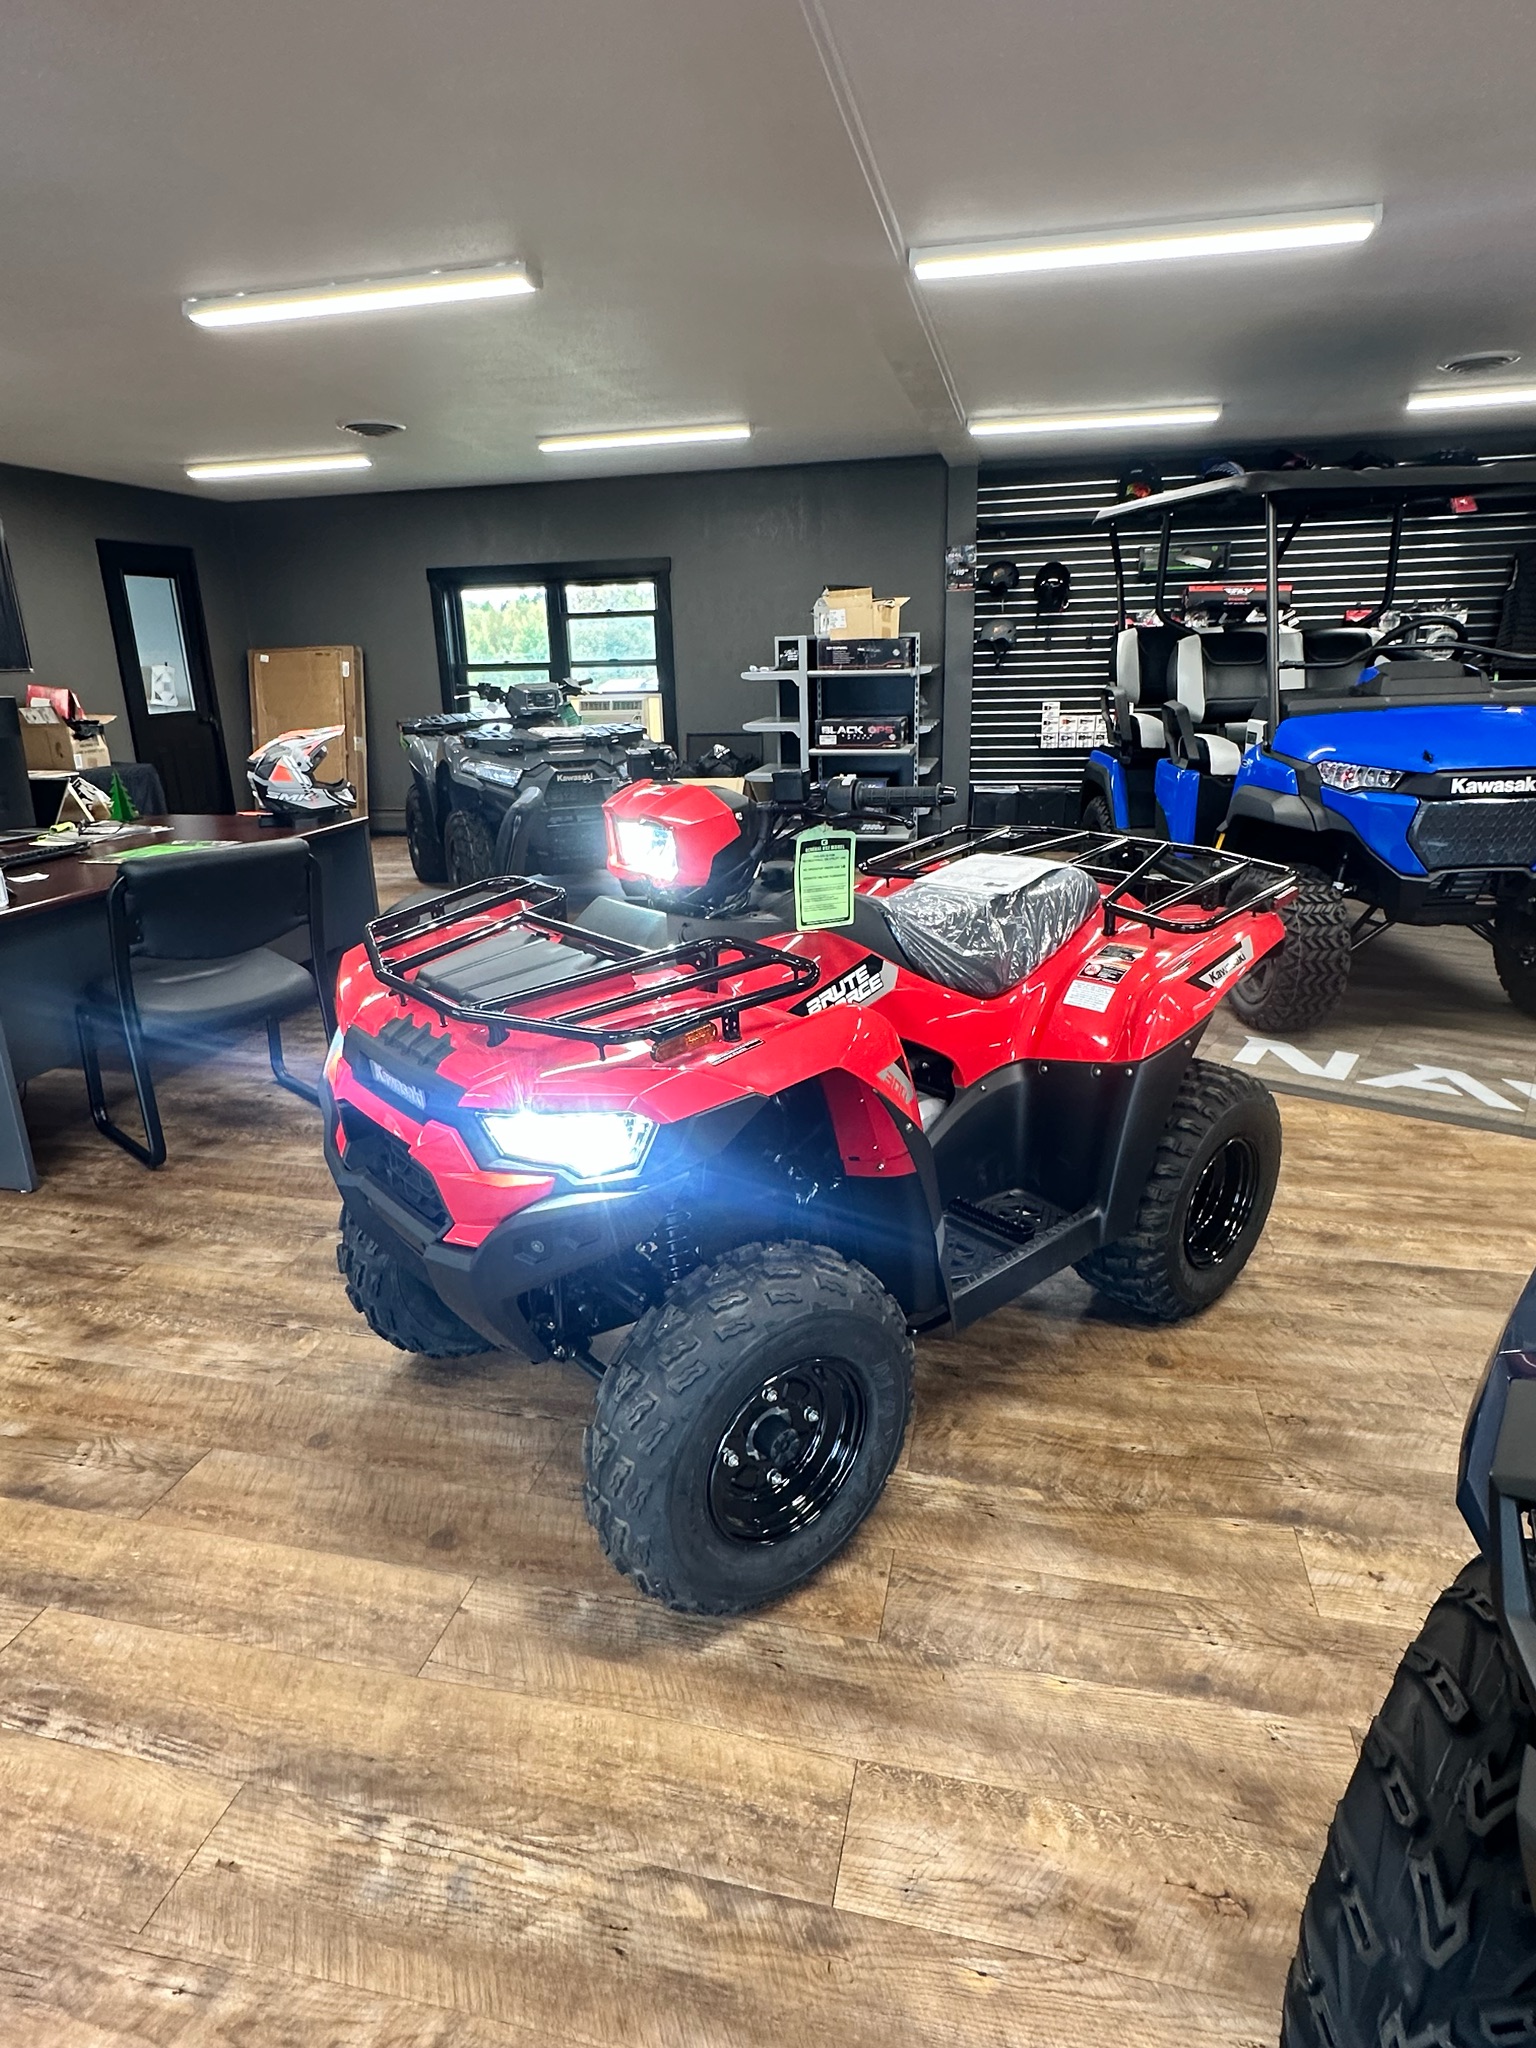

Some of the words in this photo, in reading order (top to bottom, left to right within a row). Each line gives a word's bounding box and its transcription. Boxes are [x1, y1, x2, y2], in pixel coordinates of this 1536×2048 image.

[821, 725, 864, 735] BLACK
[868, 725, 895, 735] OPS
[556, 772, 594, 782] Kawasaki
[266, 791, 312, 802] SMK
[806, 964, 870, 1015] BRUTE
[833, 972, 884, 1004] RCE
[369, 1059, 426, 1110] Kawasaki
[1232, 1036, 1536, 1112] NA
